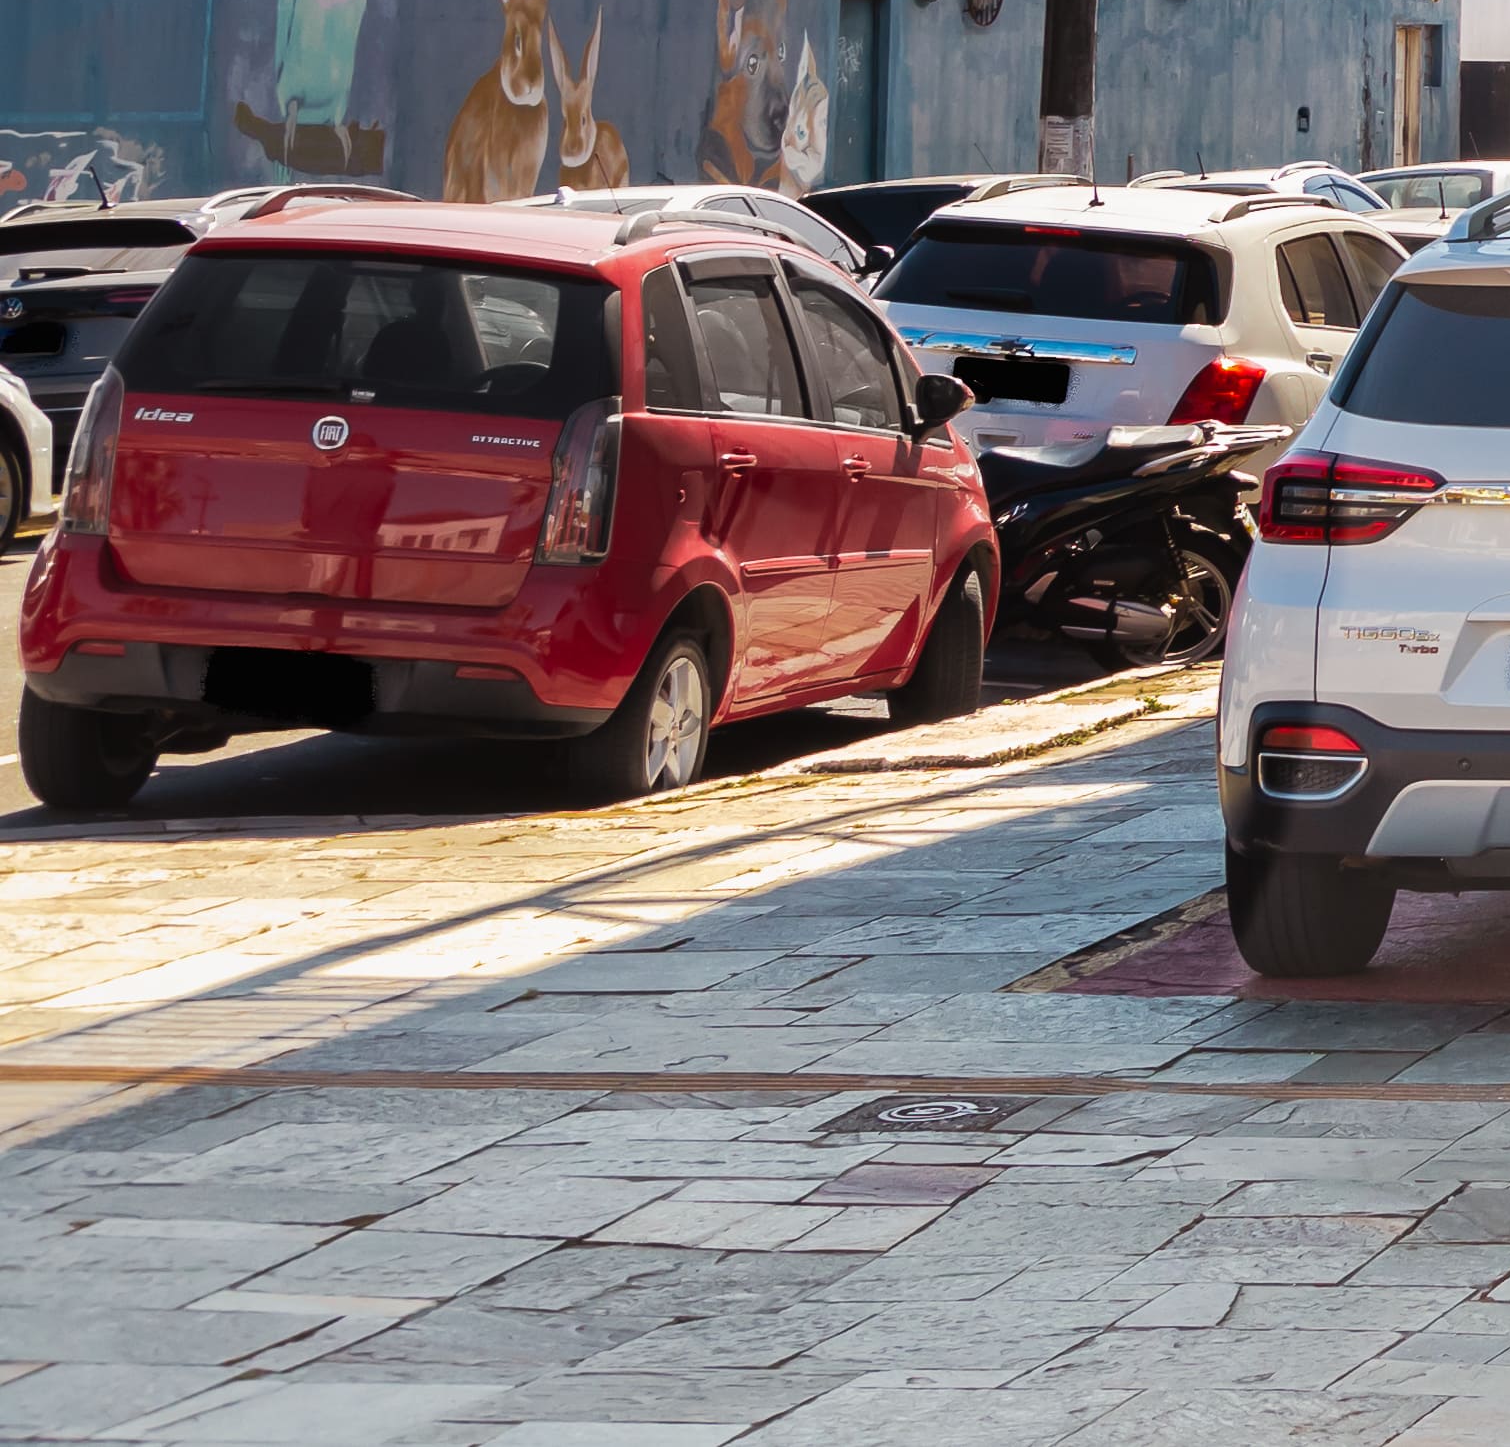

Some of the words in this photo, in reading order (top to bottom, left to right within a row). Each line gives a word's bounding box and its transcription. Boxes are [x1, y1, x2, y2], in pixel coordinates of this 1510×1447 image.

[134, 407, 194, 423] Idea
[319, 425, 342, 442] FIAT
[471, 435, 541, 448] ATTRACTIVE
